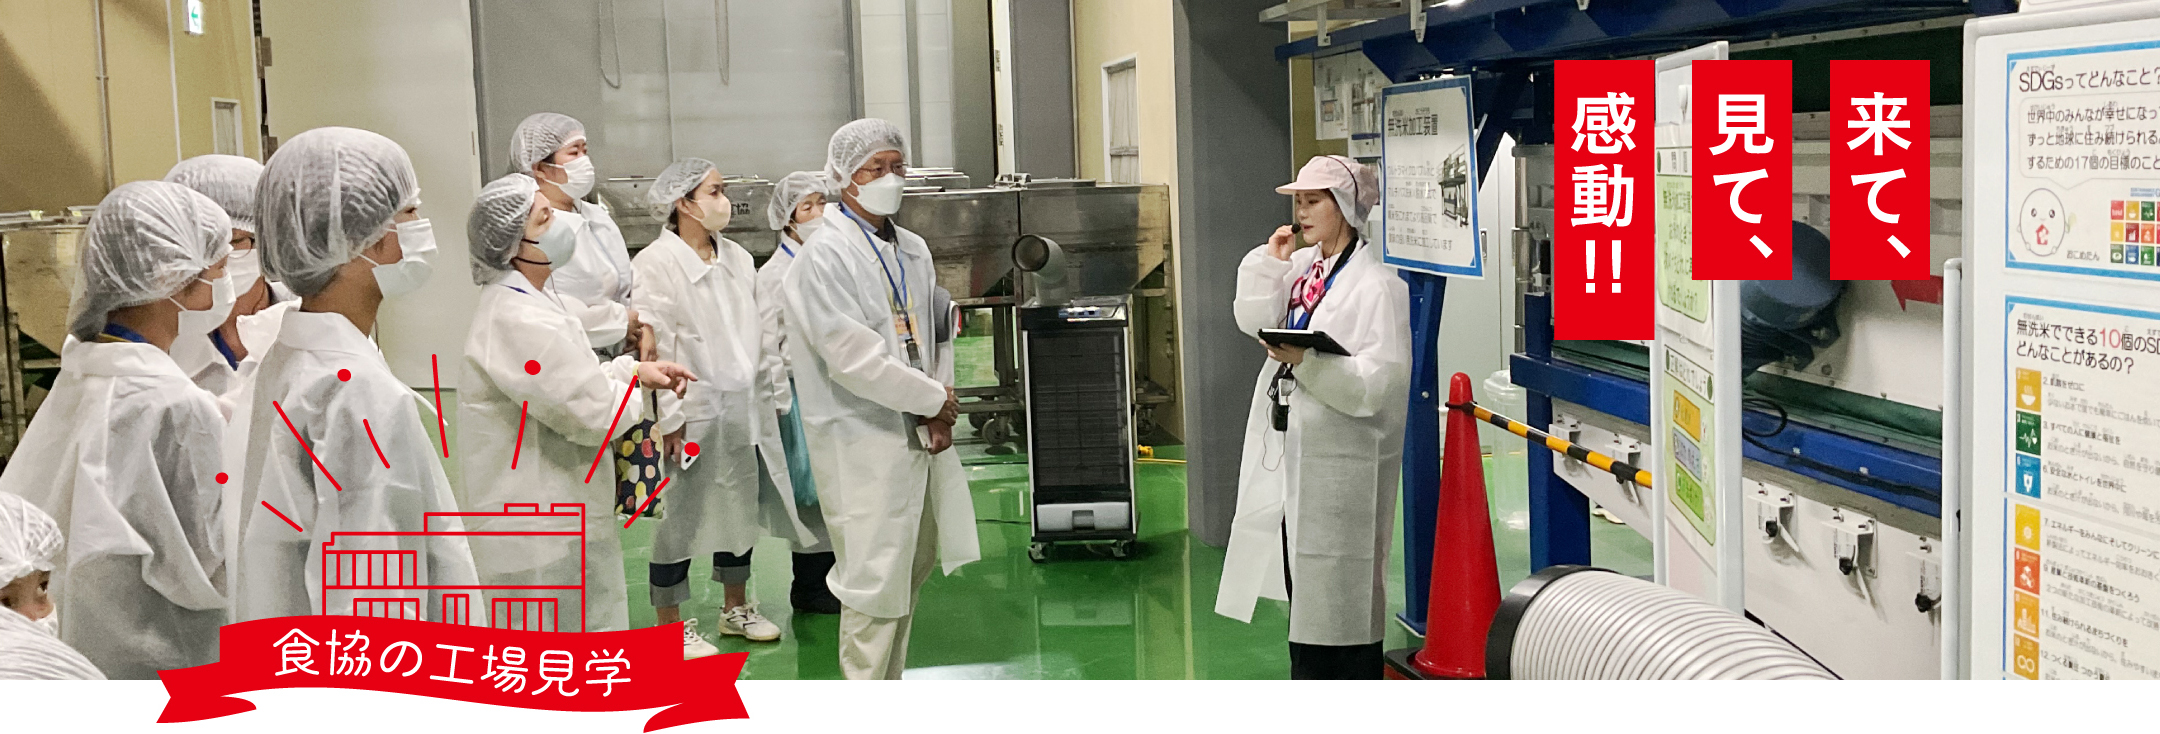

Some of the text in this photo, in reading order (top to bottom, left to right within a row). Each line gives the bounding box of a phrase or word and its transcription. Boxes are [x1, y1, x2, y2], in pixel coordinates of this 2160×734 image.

[2027, 107, 2160, 124] 世界中のみんなが幸せになっ
[2027, 130, 2160, 147] ずっと地球に住み続けられる
[2016, 340, 2134, 374] どんなことがあるの?
